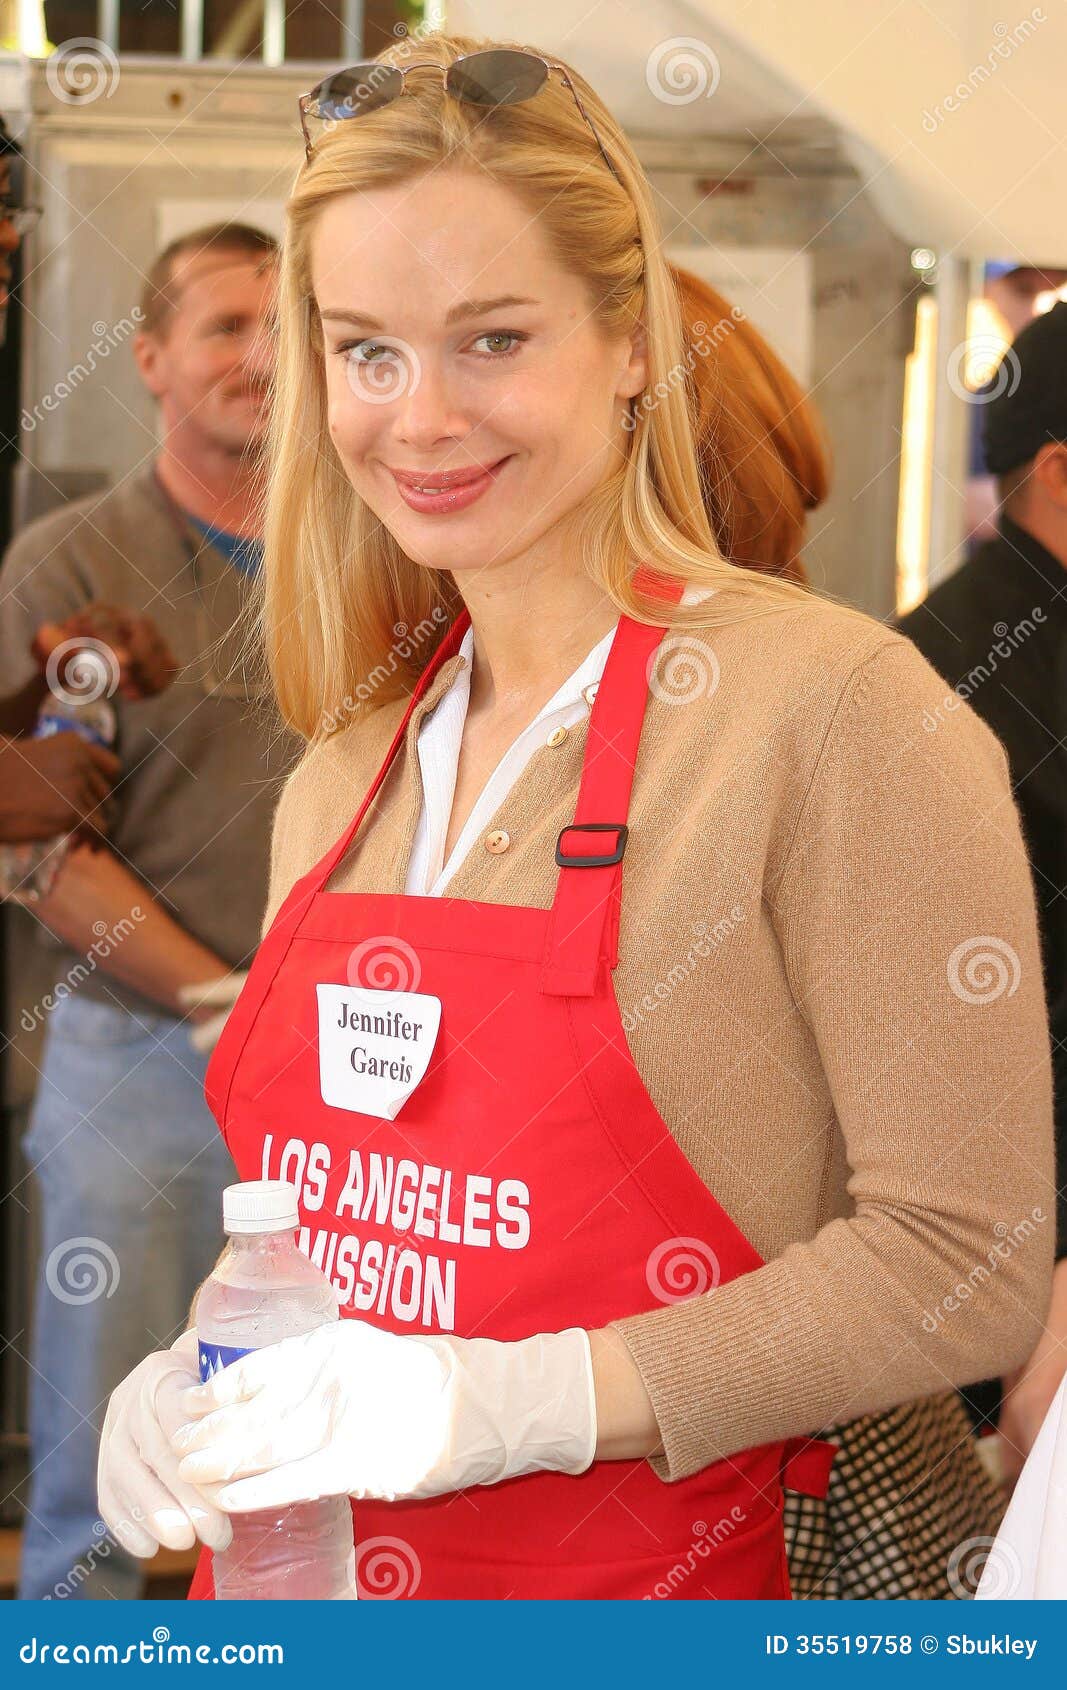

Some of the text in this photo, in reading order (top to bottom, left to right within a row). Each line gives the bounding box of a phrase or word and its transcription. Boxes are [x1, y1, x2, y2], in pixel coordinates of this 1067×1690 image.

[337, 1002, 423, 1042] Jennifer
[350, 1046, 413, 1084] Gareis
[262, 1134, 531, 1250] LOS ANGELES
